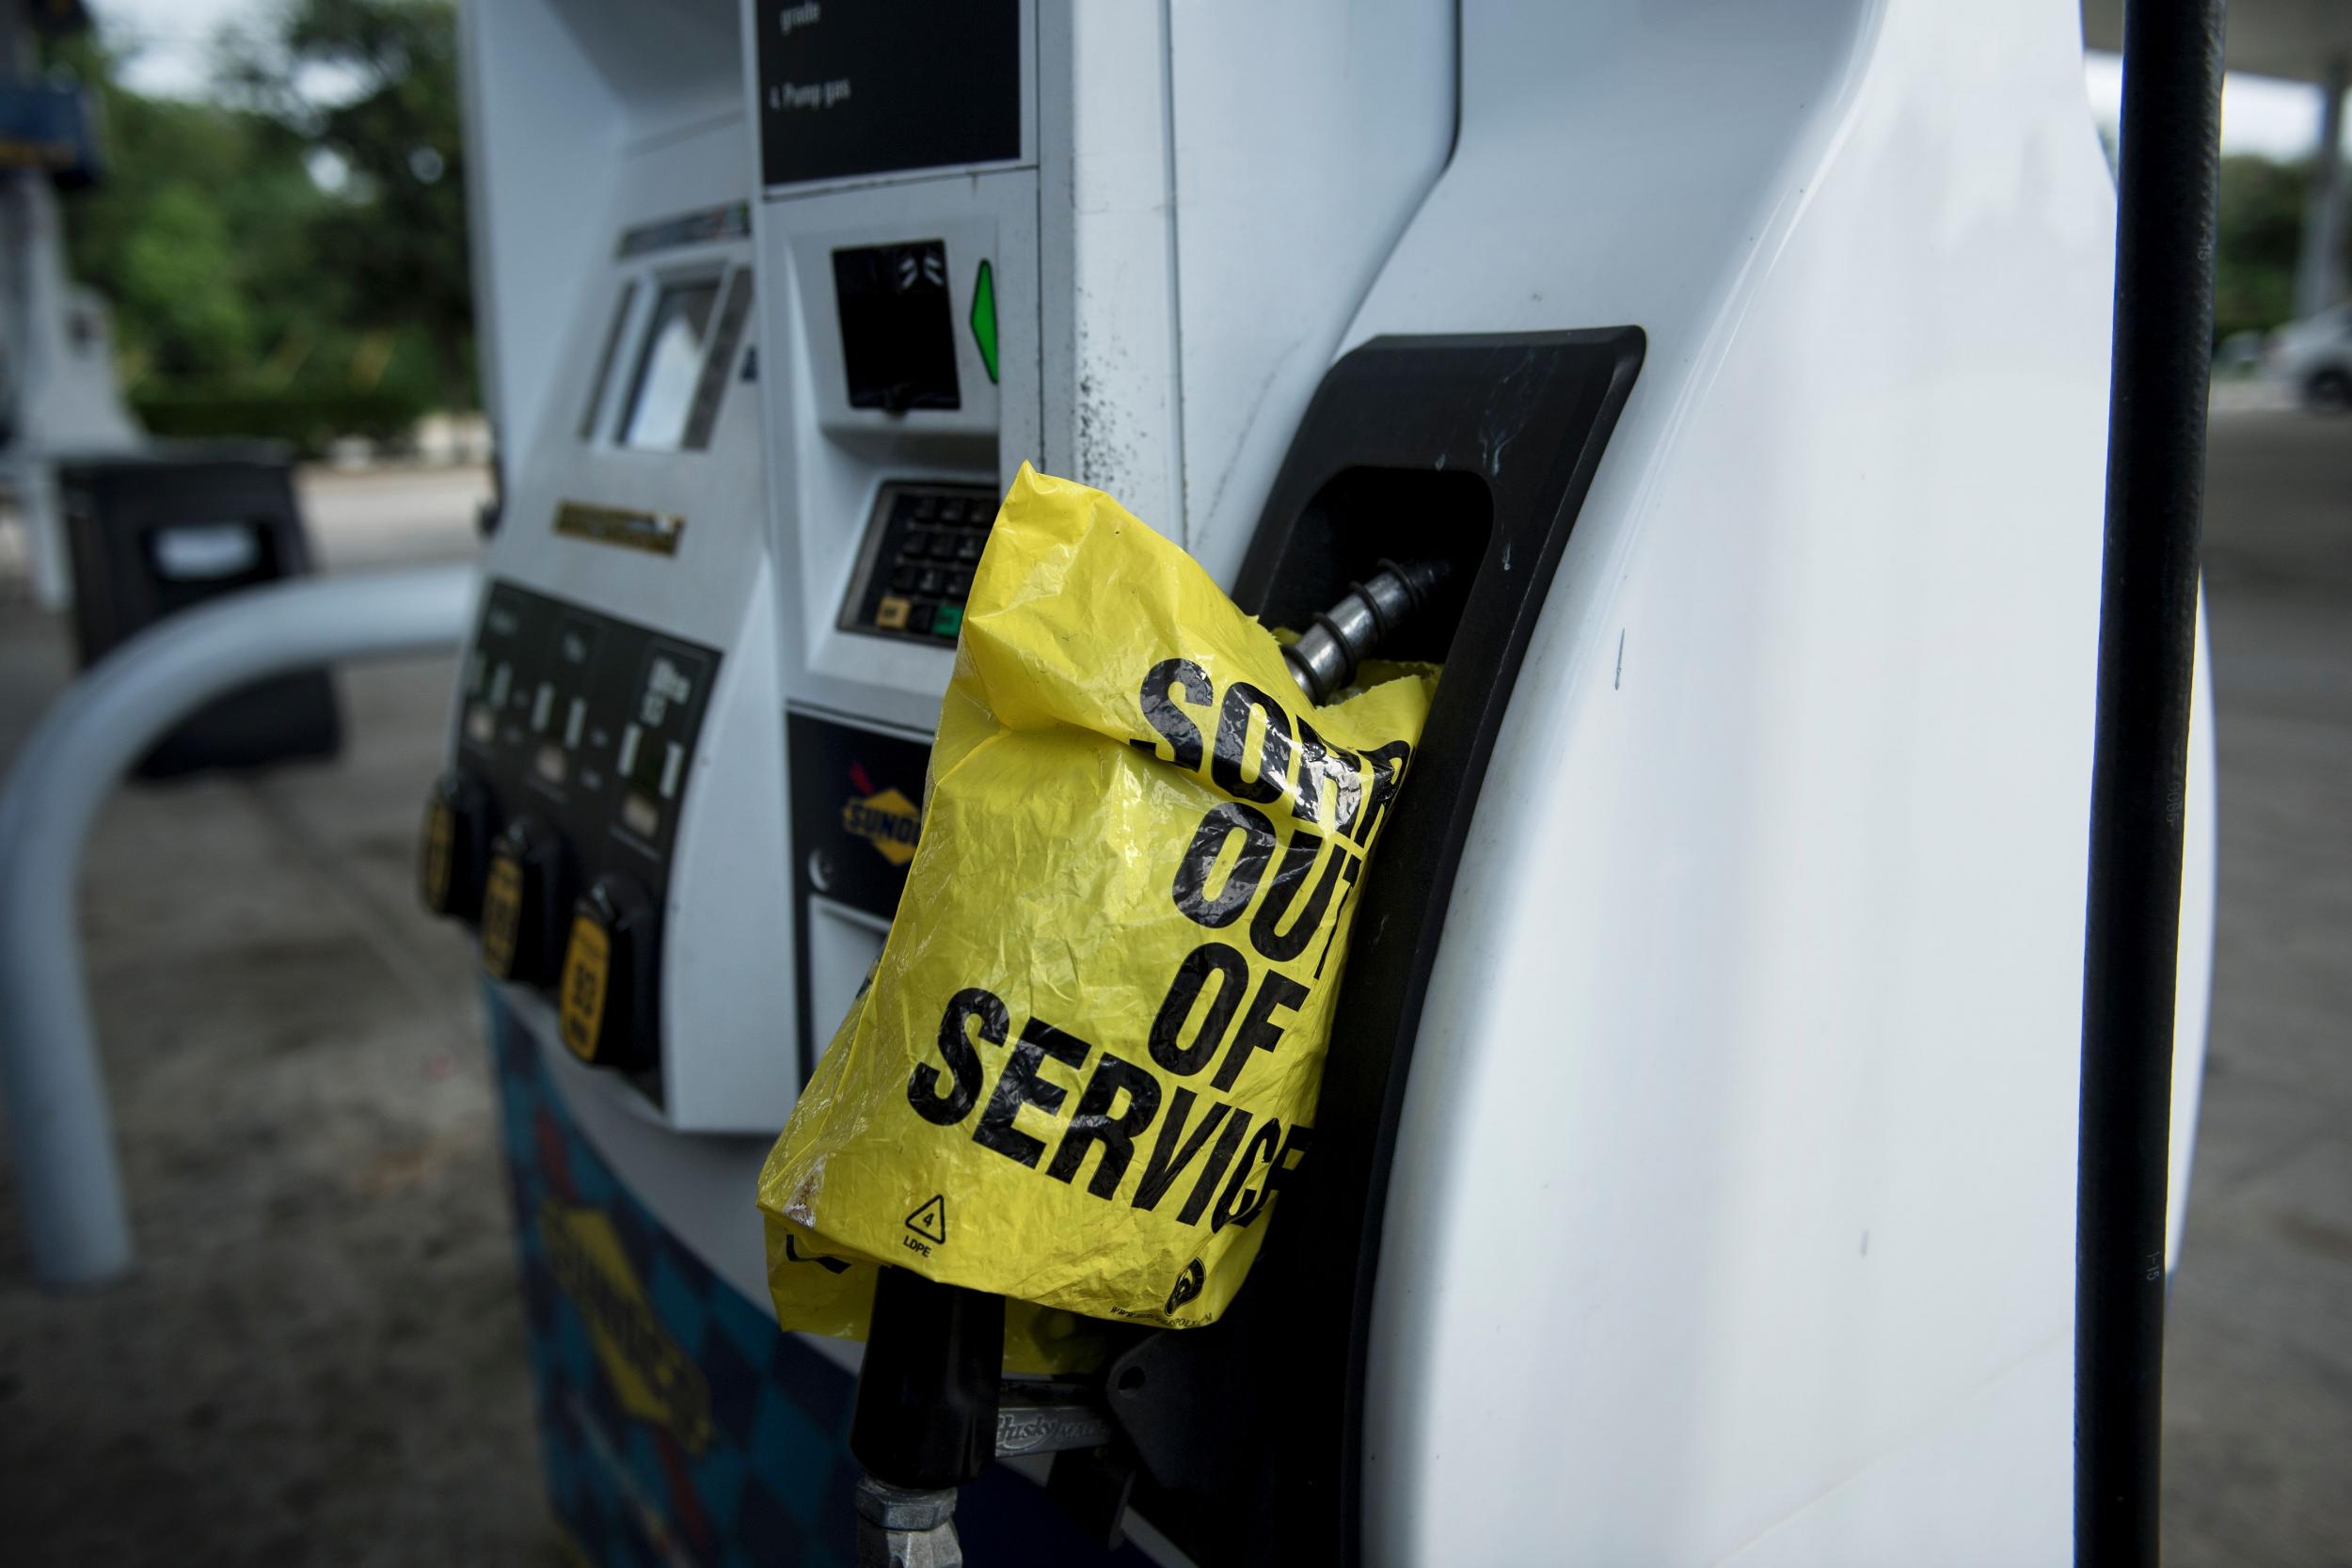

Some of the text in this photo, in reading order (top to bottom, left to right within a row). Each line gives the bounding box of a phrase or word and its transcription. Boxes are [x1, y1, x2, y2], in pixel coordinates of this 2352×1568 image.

[782, 81, 820, 111] Pump
[823, 78, 850, 108] gas
[1129, 657, 1411, 848] SORR
[848, 802, 921, 846] SUNO
[1148, 942, 1311, 1094] OF
[907, 987, 1314, 1235] SERVICE
[923, 1212, 935, 1227] 4
[903, 1235, 932, 1258] LDPE
